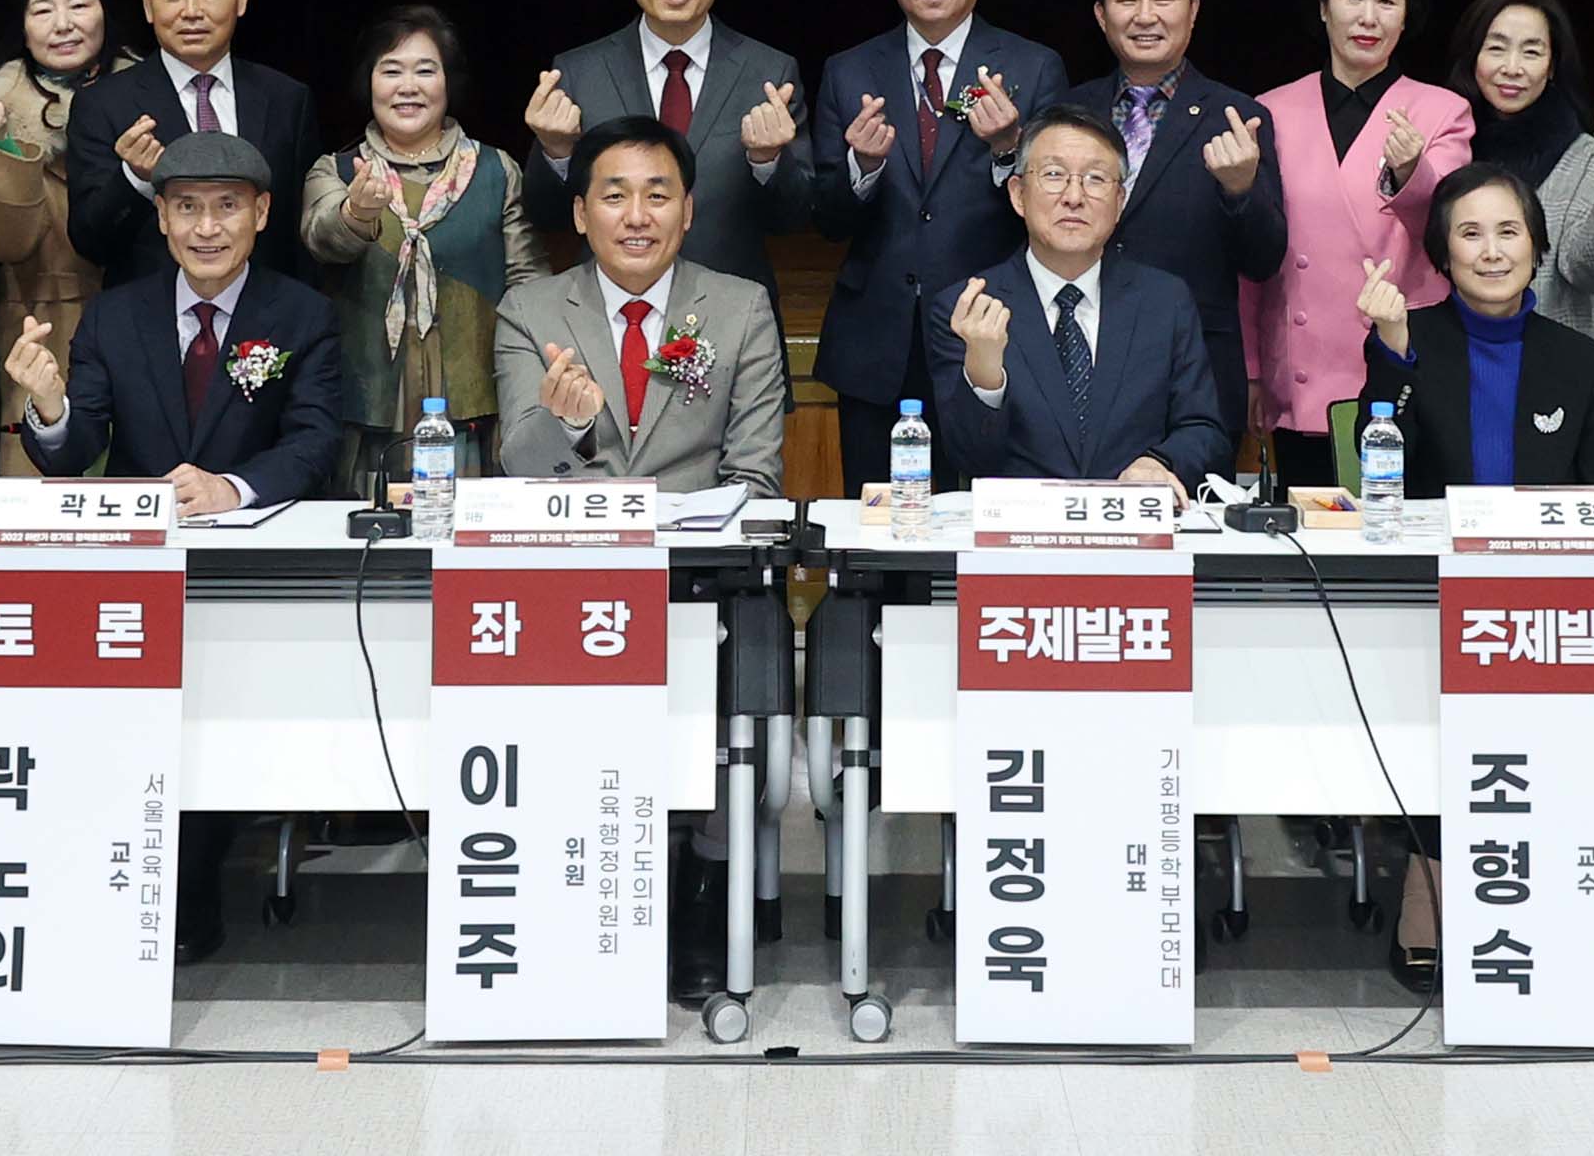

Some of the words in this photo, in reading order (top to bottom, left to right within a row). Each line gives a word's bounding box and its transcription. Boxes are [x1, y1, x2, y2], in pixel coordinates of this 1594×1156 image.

[979, 607, 1171, 662] 주제발표
[109, 842, 130, 891] 교수
[139, 774, 164, 961] 서울교육대학교
[456, 745, 519, 989] 이은주
[565, 837, 584, 886] 위원
[598, 770, 619, 954] 교육행정위원회
[633, 796, 653, 926] 경기도의회
[985, 750, 1047, 992] 김정욱
[1127, 844, 1147, 892] 대표
[1161, 749, 1181, 988] 기회평등학부모연대
[1469, 754, 1533, 995] 조형숙
